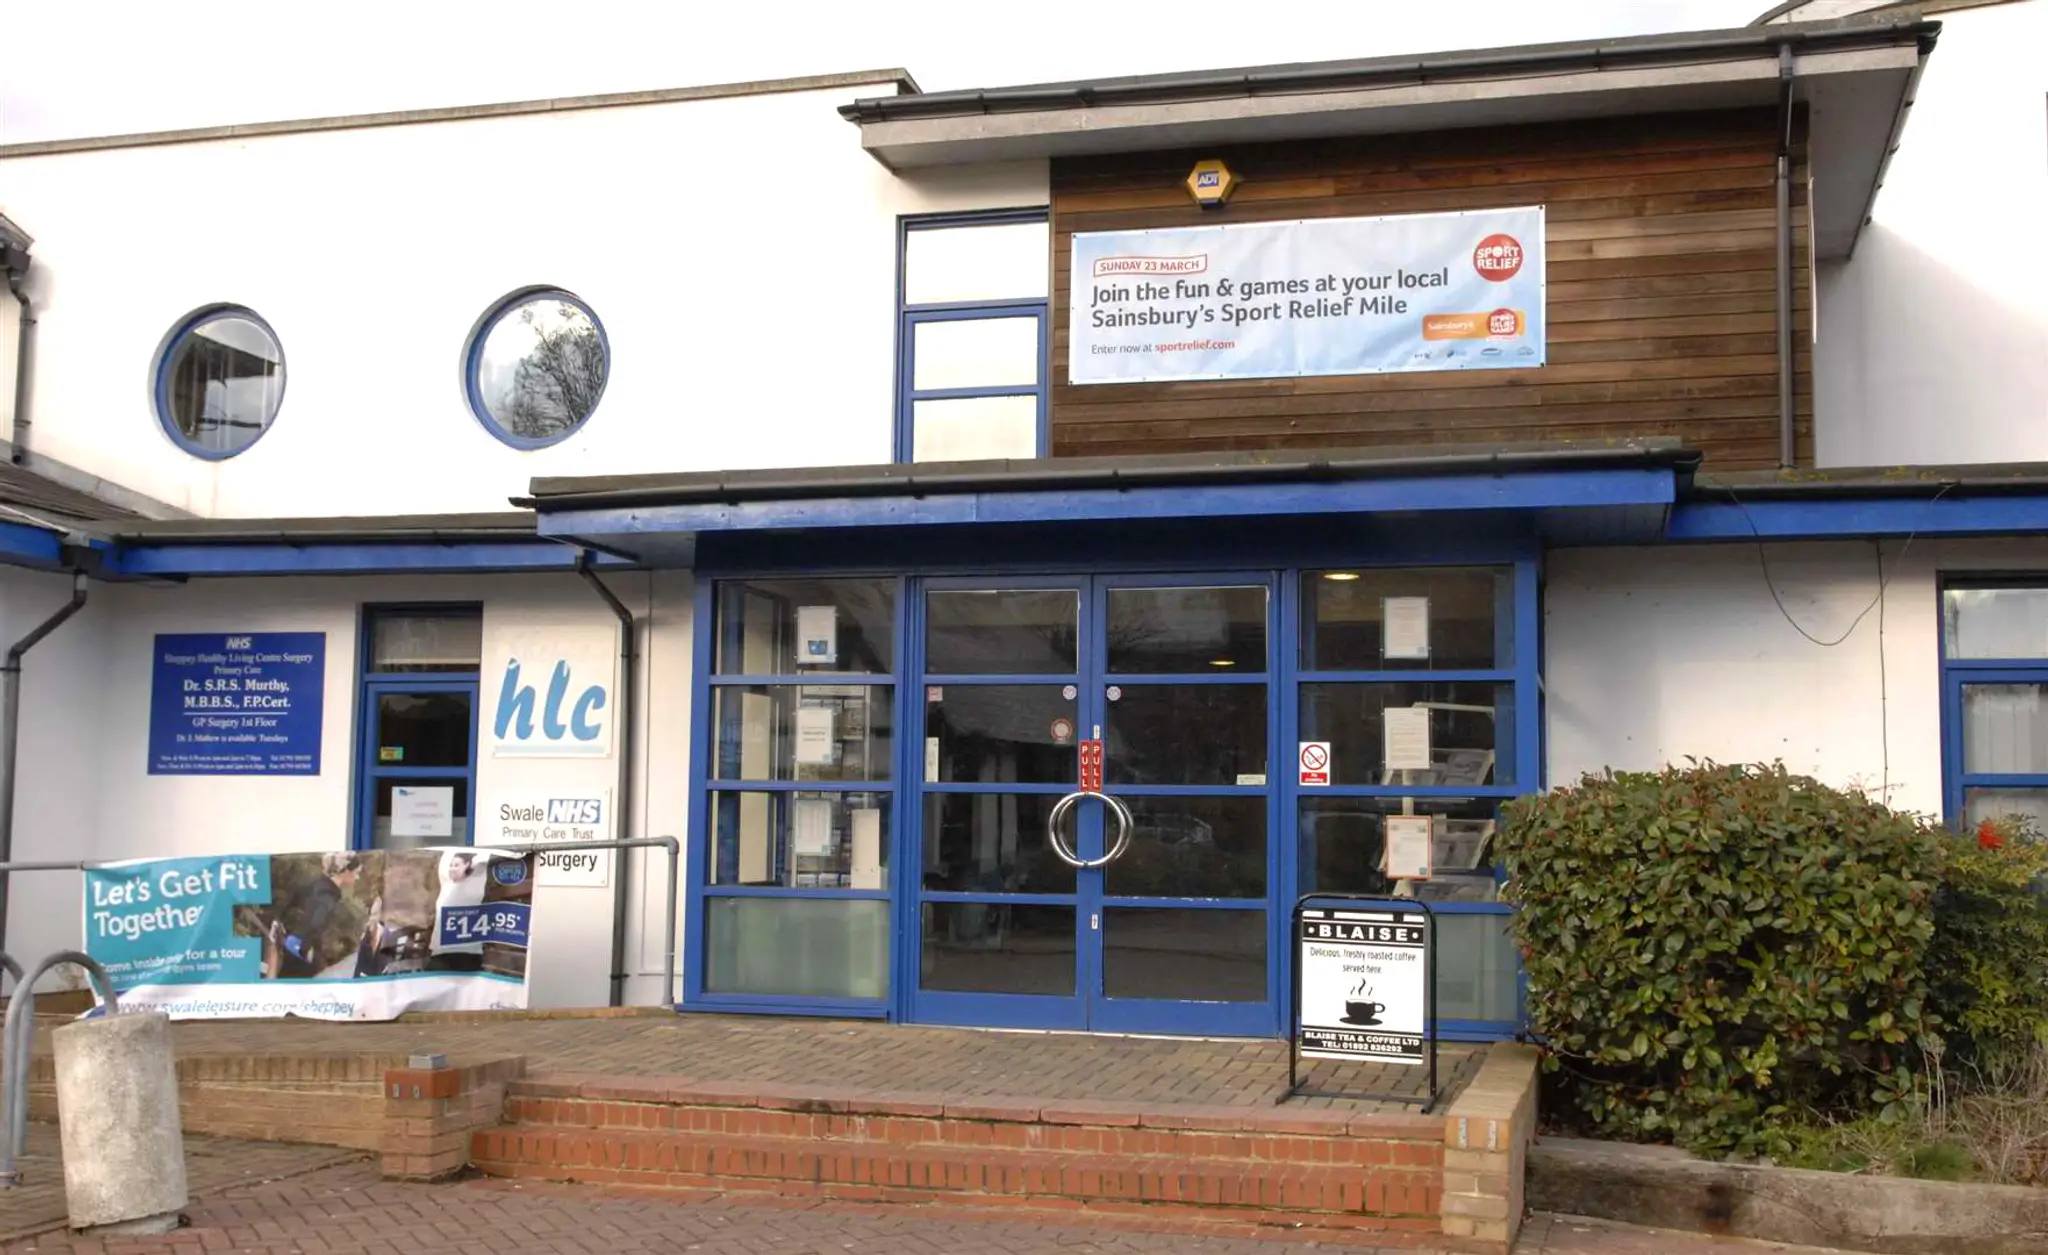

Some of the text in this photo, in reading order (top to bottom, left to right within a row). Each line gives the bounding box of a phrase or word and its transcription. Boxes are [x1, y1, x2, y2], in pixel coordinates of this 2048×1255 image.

[1476, 246, 1520, 259] SPORT
[1100, 260, 1199, 271] SUNDAY 23 MARCH
[1477, 257, 1520, 270] RELIEF
[1091, 267, 1448, 307] Join the fun & games at your local
[1092, 295, 1407, 329] Sainsbury's Sport Relief Mile
[1091, 339, 1235, 354] Enter now at sportrelief.com
[226, 637, 252, 649] NHS
[283, 652, 313, 664] Surgery
[184, 679, 289, 693] Dr. S.R.S. Murthy,
[493, 658, 606, 741] hlc
[208, 717, 239, 729] Surgery
[255, 717, 277, 727] Floor
[500, 799, 600, 823] Swale NHS
[502, 826, 594, 841] Primary Care Trust
[93, 863, 258, 907] Let's Get Fit
[1319, 924, 1408, 941] BLAISE
[186, 949, 206, 960] for
[220, 948, 246, 959] tour
[1344, 949, 1365, 961] freshly
[1367, 951, 1393, 960] roasted
[1395, 952, 1417, 962] coffee
[1342, 964, 1365, 973] served
[1305, 1032, 1337, 1040] BLAISE
[1338, 1034, 1356, 1042] TEA
[1366, 1036, 1401, 1045] COFFEE
[1402, 1038, 1420, 1046] LTD
